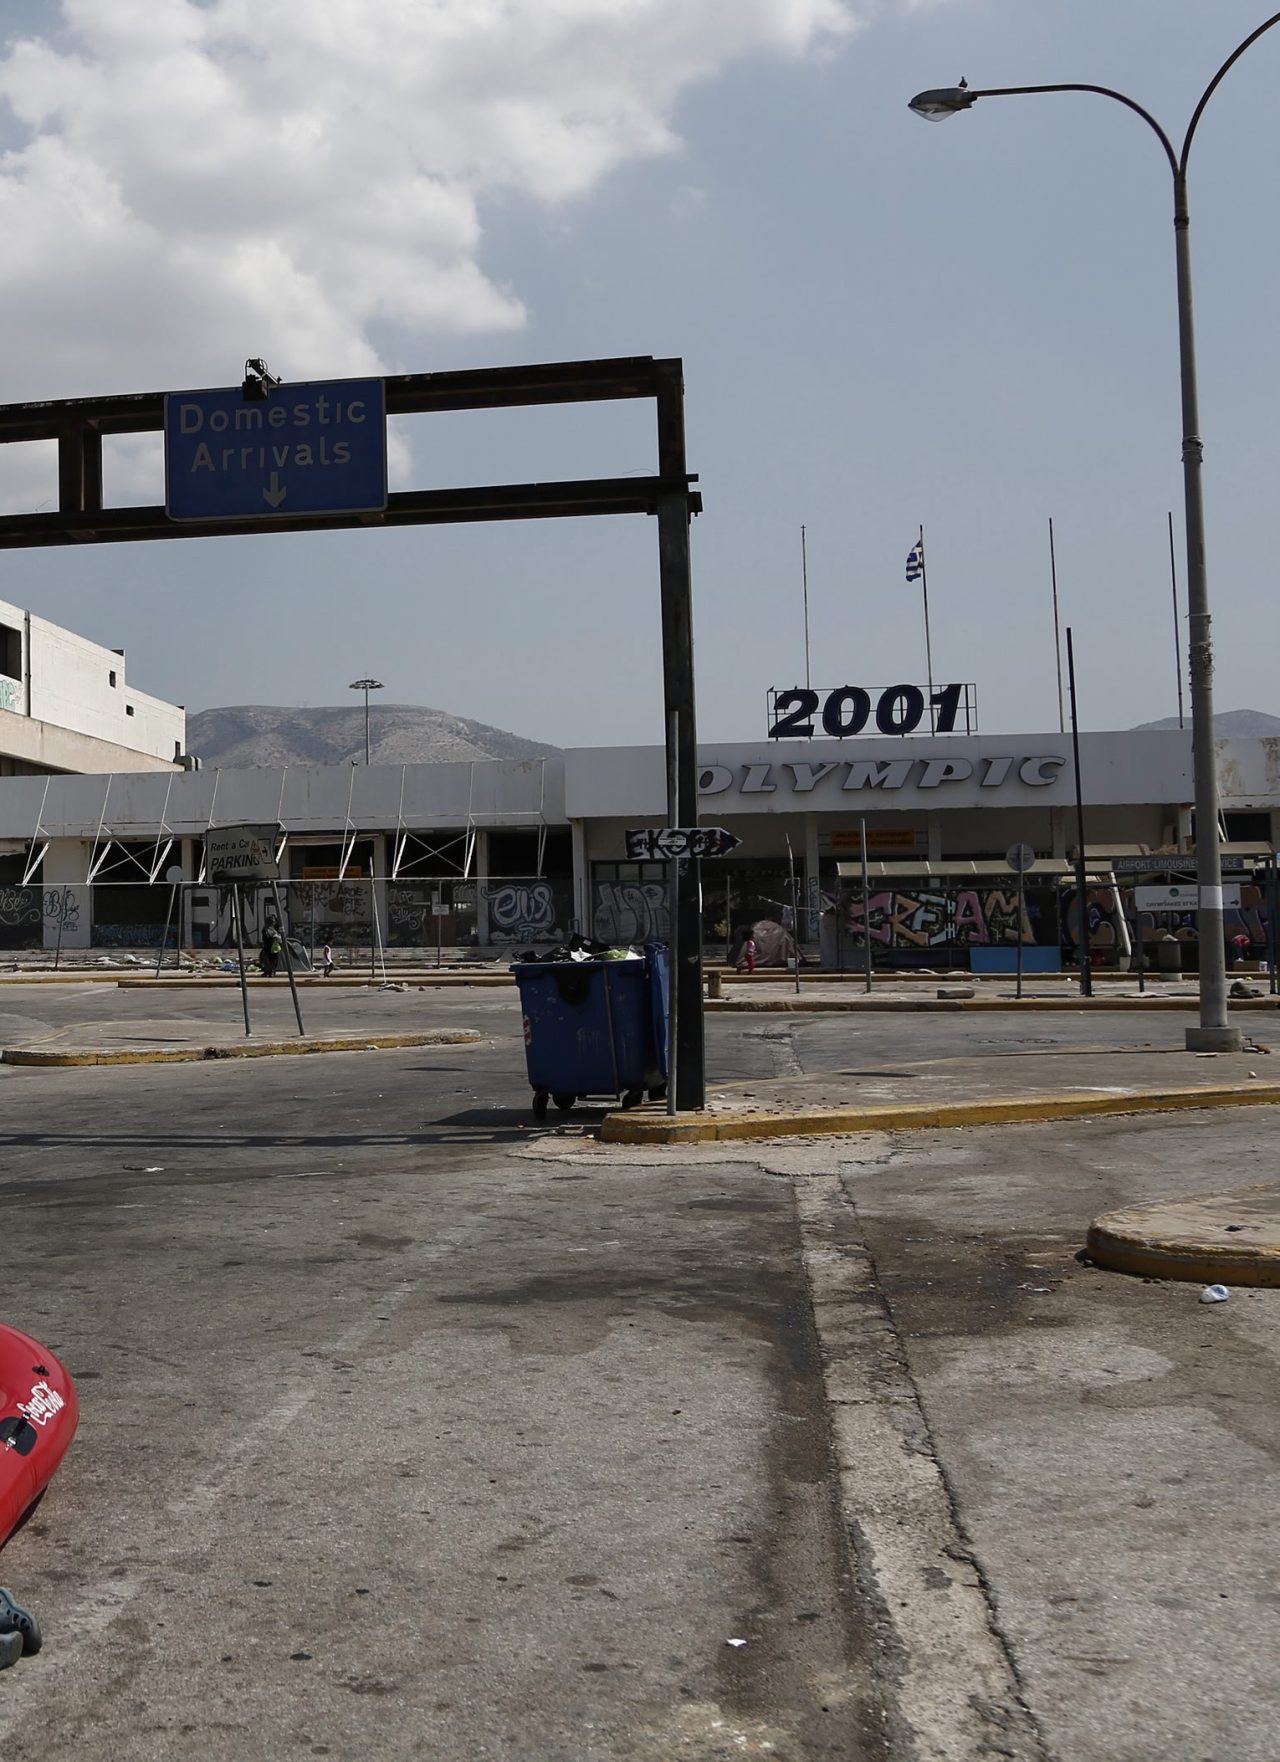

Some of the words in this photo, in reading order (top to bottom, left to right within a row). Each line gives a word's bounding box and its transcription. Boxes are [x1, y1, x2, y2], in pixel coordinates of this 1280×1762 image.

[179, 394, 368, 435] Domestic
[190, 436, 353, 473] Arrivals
[768, 683, 963, 738] 2001
[697, 755, 1067, 796] OLYMPIC
[211, 841, 229, 852] Rent
